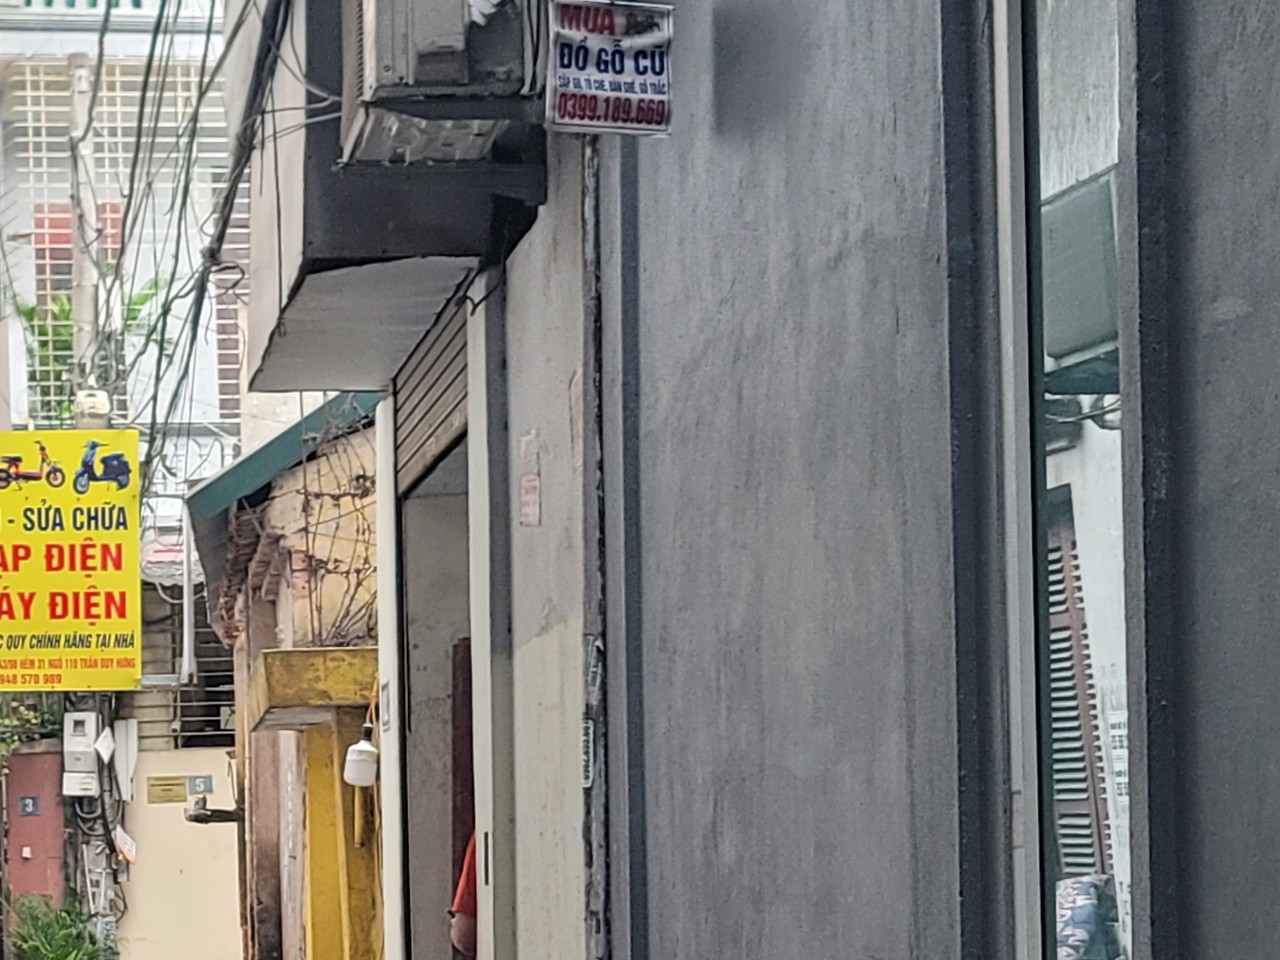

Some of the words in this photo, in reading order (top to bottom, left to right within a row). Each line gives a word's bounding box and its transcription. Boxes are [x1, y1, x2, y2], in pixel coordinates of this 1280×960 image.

[560, 4, 614, 35] MUA
[596, 39, 625, 75] GỖ
[634, 45, 665, 76] CŨ
[558, 93, 665, 125] 0399.189.669
[23, 499, 65, 532] SỬA
[72, 501, 128, 531] CHỮA
[44, 537, 123, 578] ĐIỆN
[47, 584, 127, 626] ĐIỆN
[6, 635, 26, 650] QUY
[29, 632, 61, 649] CHÍNH
[95, 634, 110, 652] TẠI
[113, 632, 135, 649] NHÀ
[21, 674, 40, 685] 570
[196, 778, 204, 791] 5
[26, 799, 33, 812] 3
